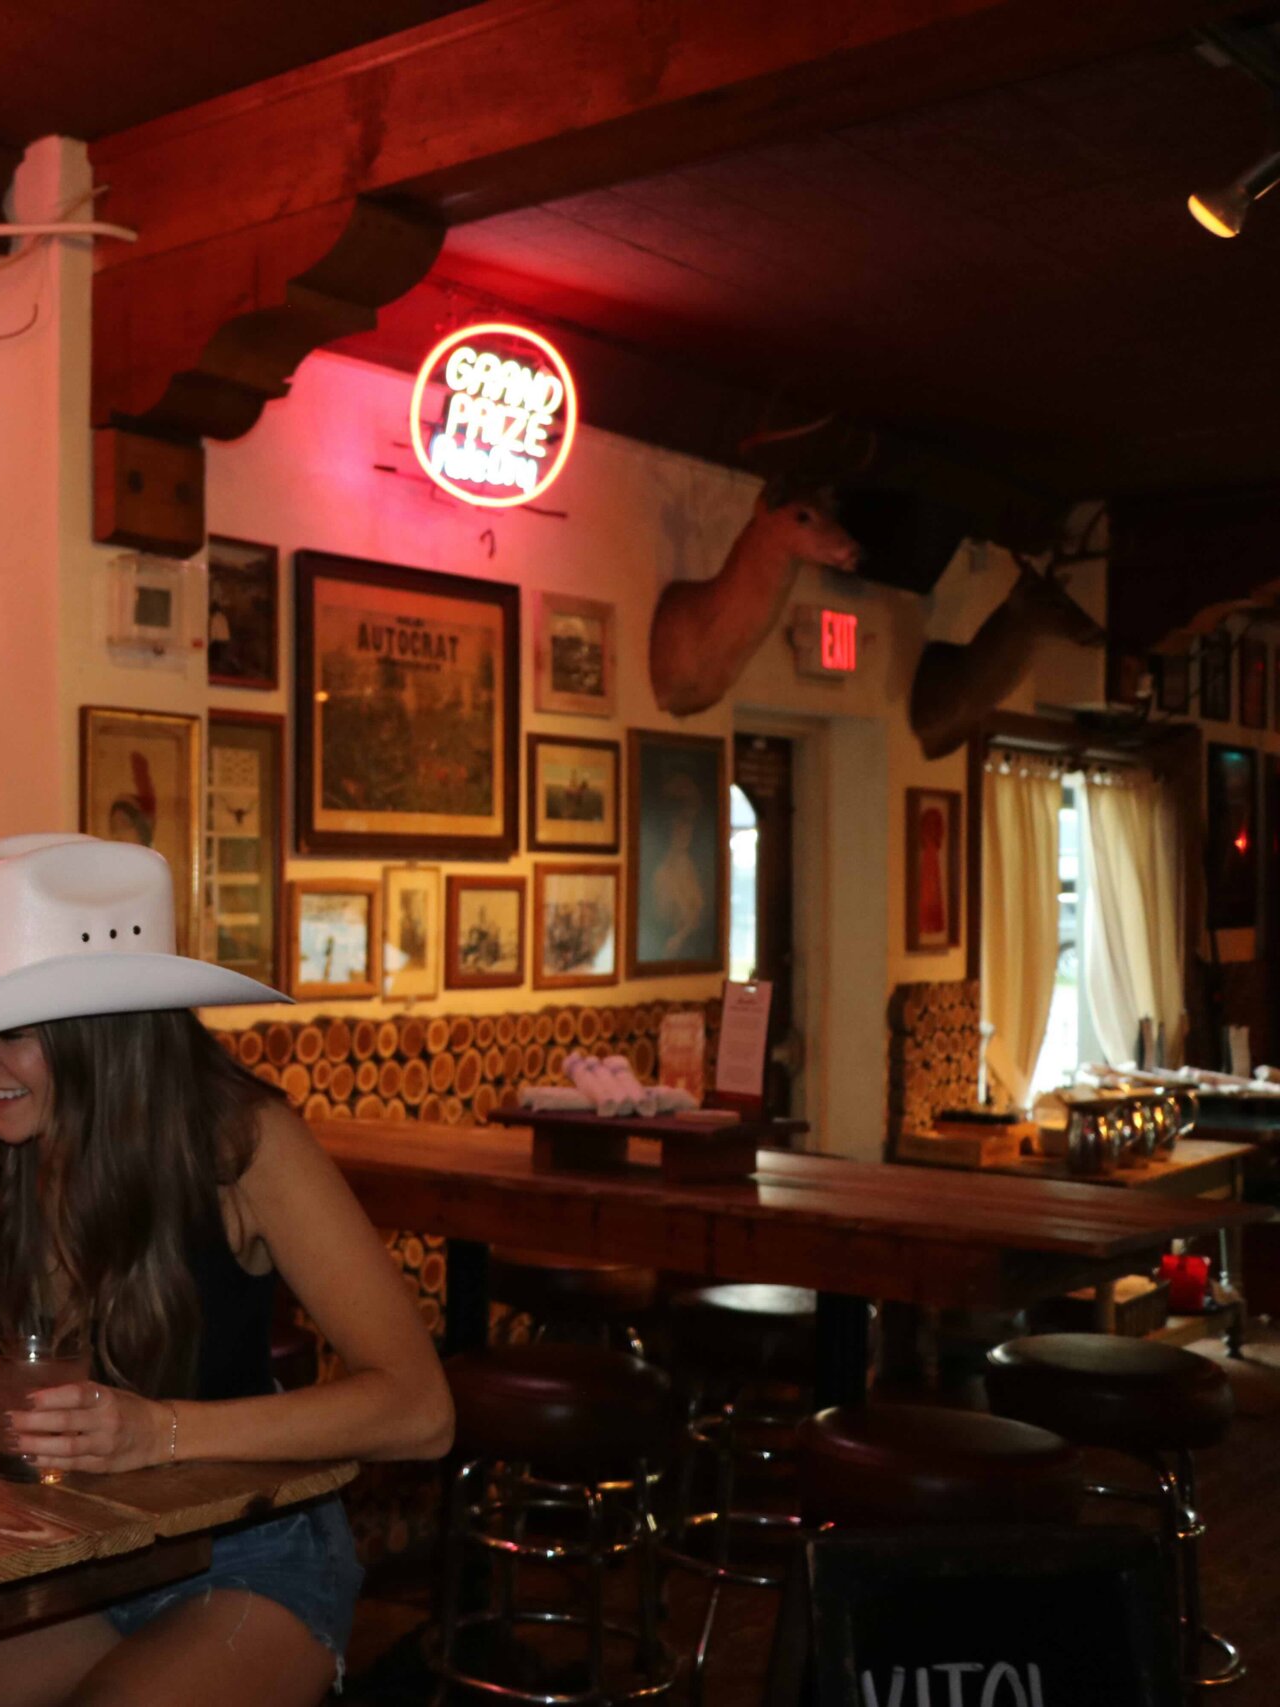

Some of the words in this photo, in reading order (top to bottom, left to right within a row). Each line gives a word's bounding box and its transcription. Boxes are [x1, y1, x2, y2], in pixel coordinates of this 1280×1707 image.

[446, 347, 563, 415] GRAND
[445, 392, 553, 458] PRIZE
[357, 622, 459, 663] AUTOCRAT
[822, 608, 858, 672] EXIT
